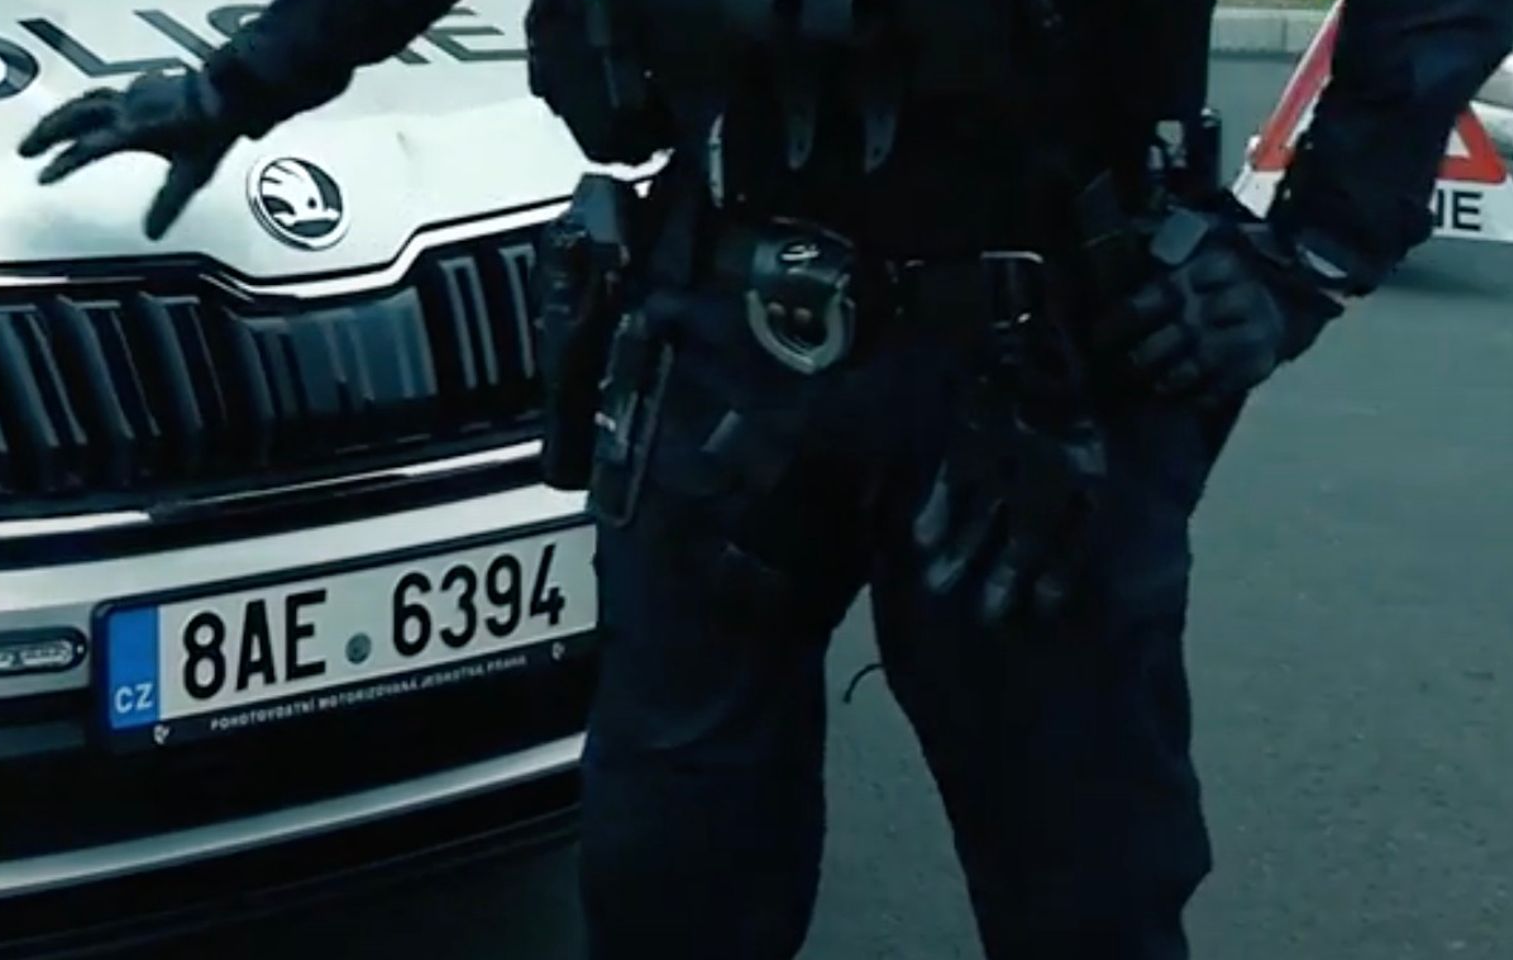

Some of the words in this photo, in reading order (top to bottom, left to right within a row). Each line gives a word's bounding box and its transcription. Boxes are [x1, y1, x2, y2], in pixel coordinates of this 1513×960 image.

[183, 588, 327, 701] 8AE
[392, 543, 566, 657] 6394
[114, 682, 154, 714] CZ
